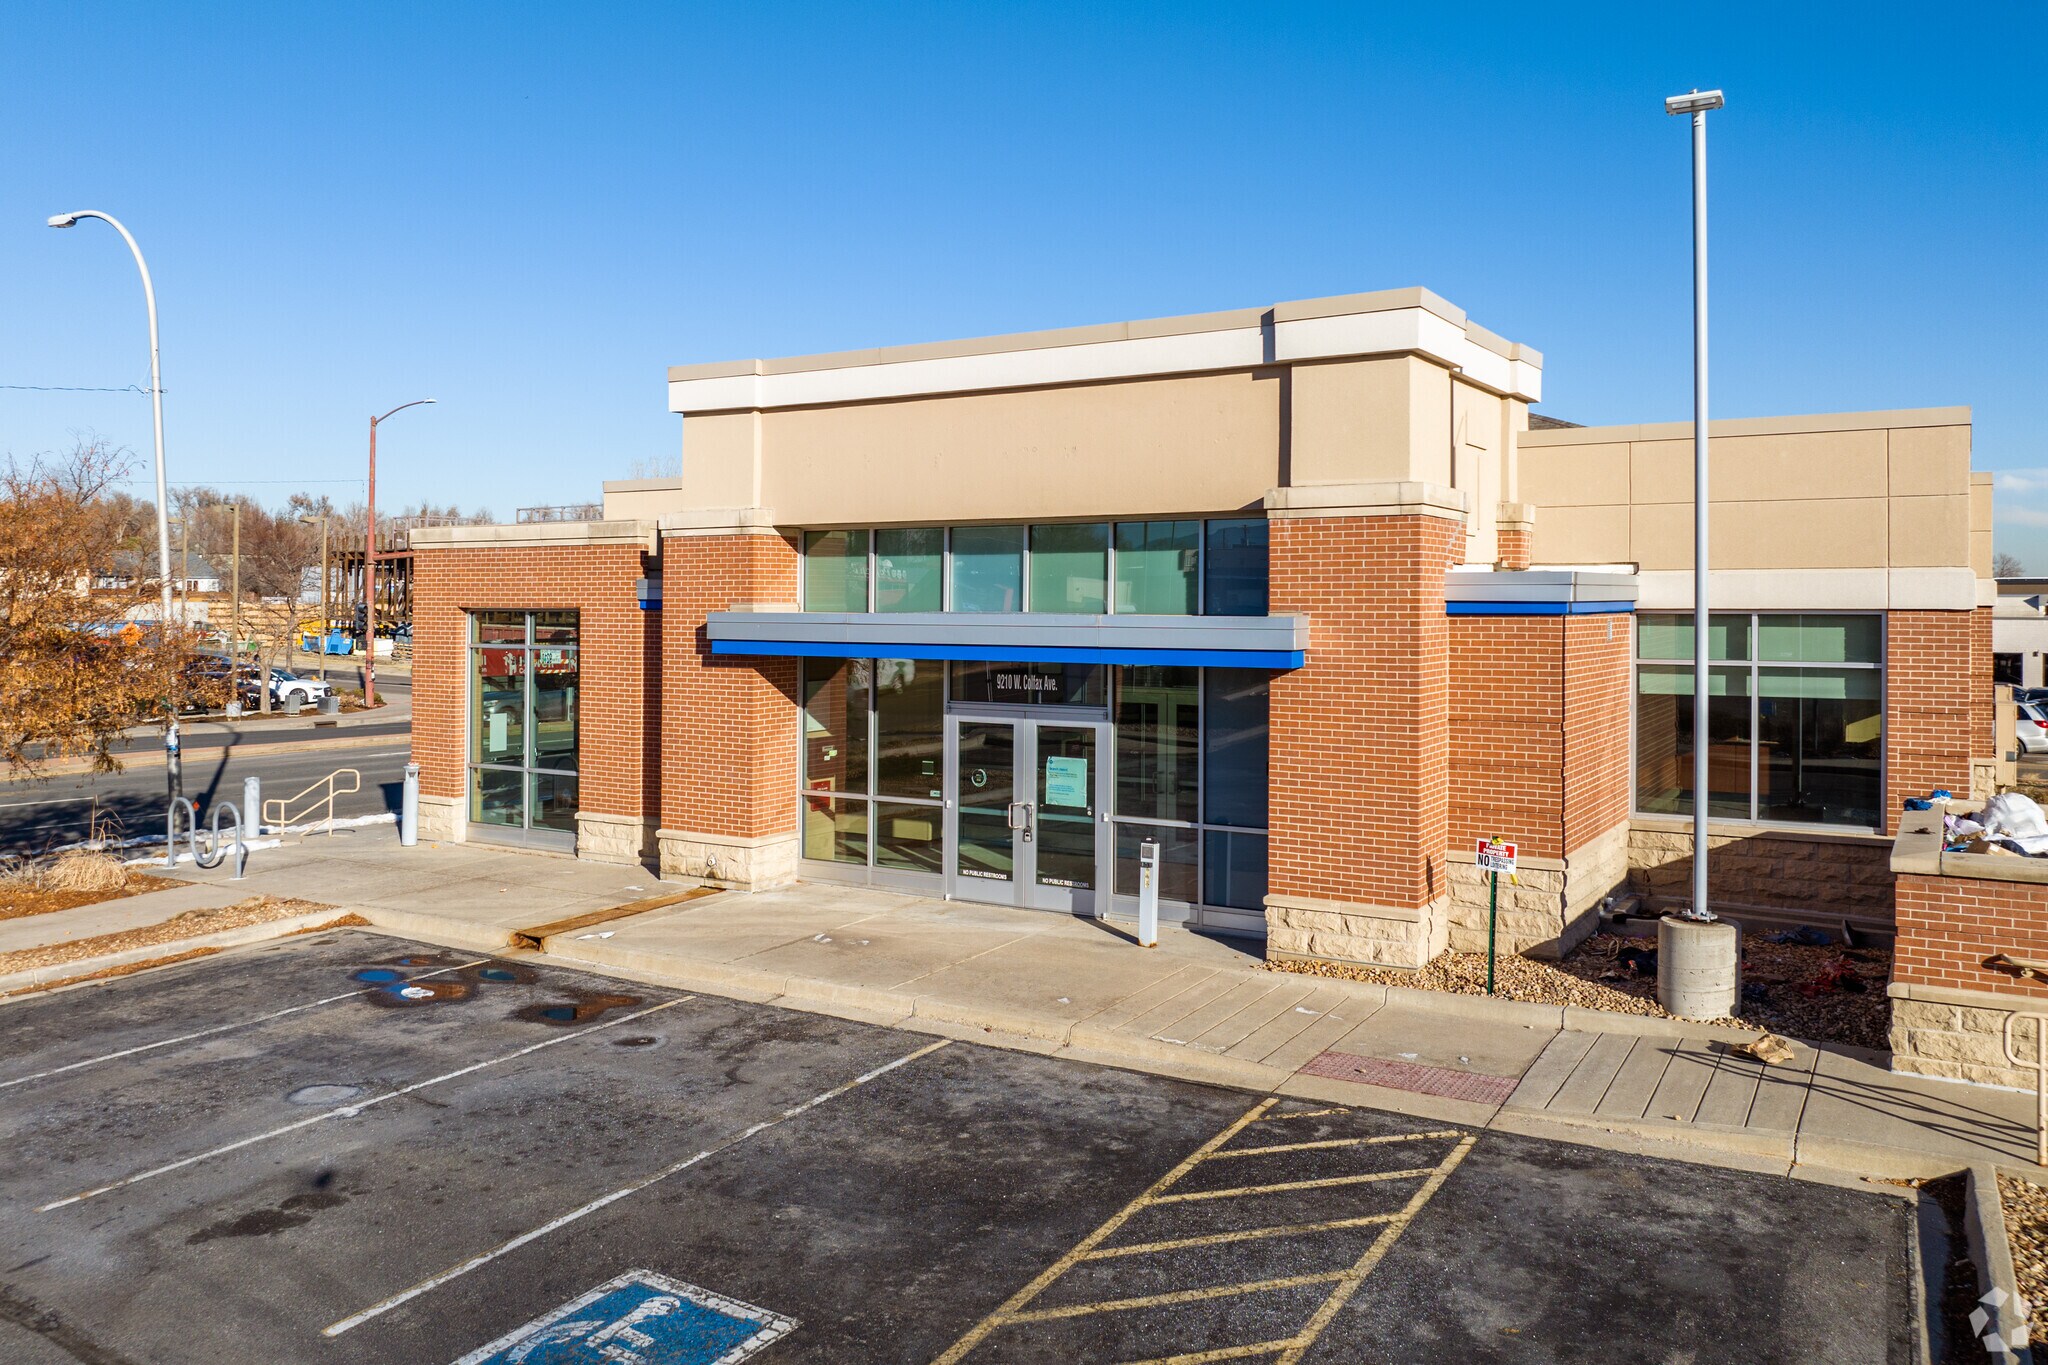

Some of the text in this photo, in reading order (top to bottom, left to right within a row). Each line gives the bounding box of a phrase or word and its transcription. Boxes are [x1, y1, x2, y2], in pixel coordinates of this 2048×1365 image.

[997, 674, 1058, 691] 9210 W. Colfax Ave.
[1483, 848, 1509, 857] PROPERTY
[1478, 854, 1514, 866] NO TRESPASSING
[1490, 861, 1508, 870] LOITERING
[983, 871, 1007, 880] RESTROOMS
[1064, 880, 1089, 888] RESTROOMS
